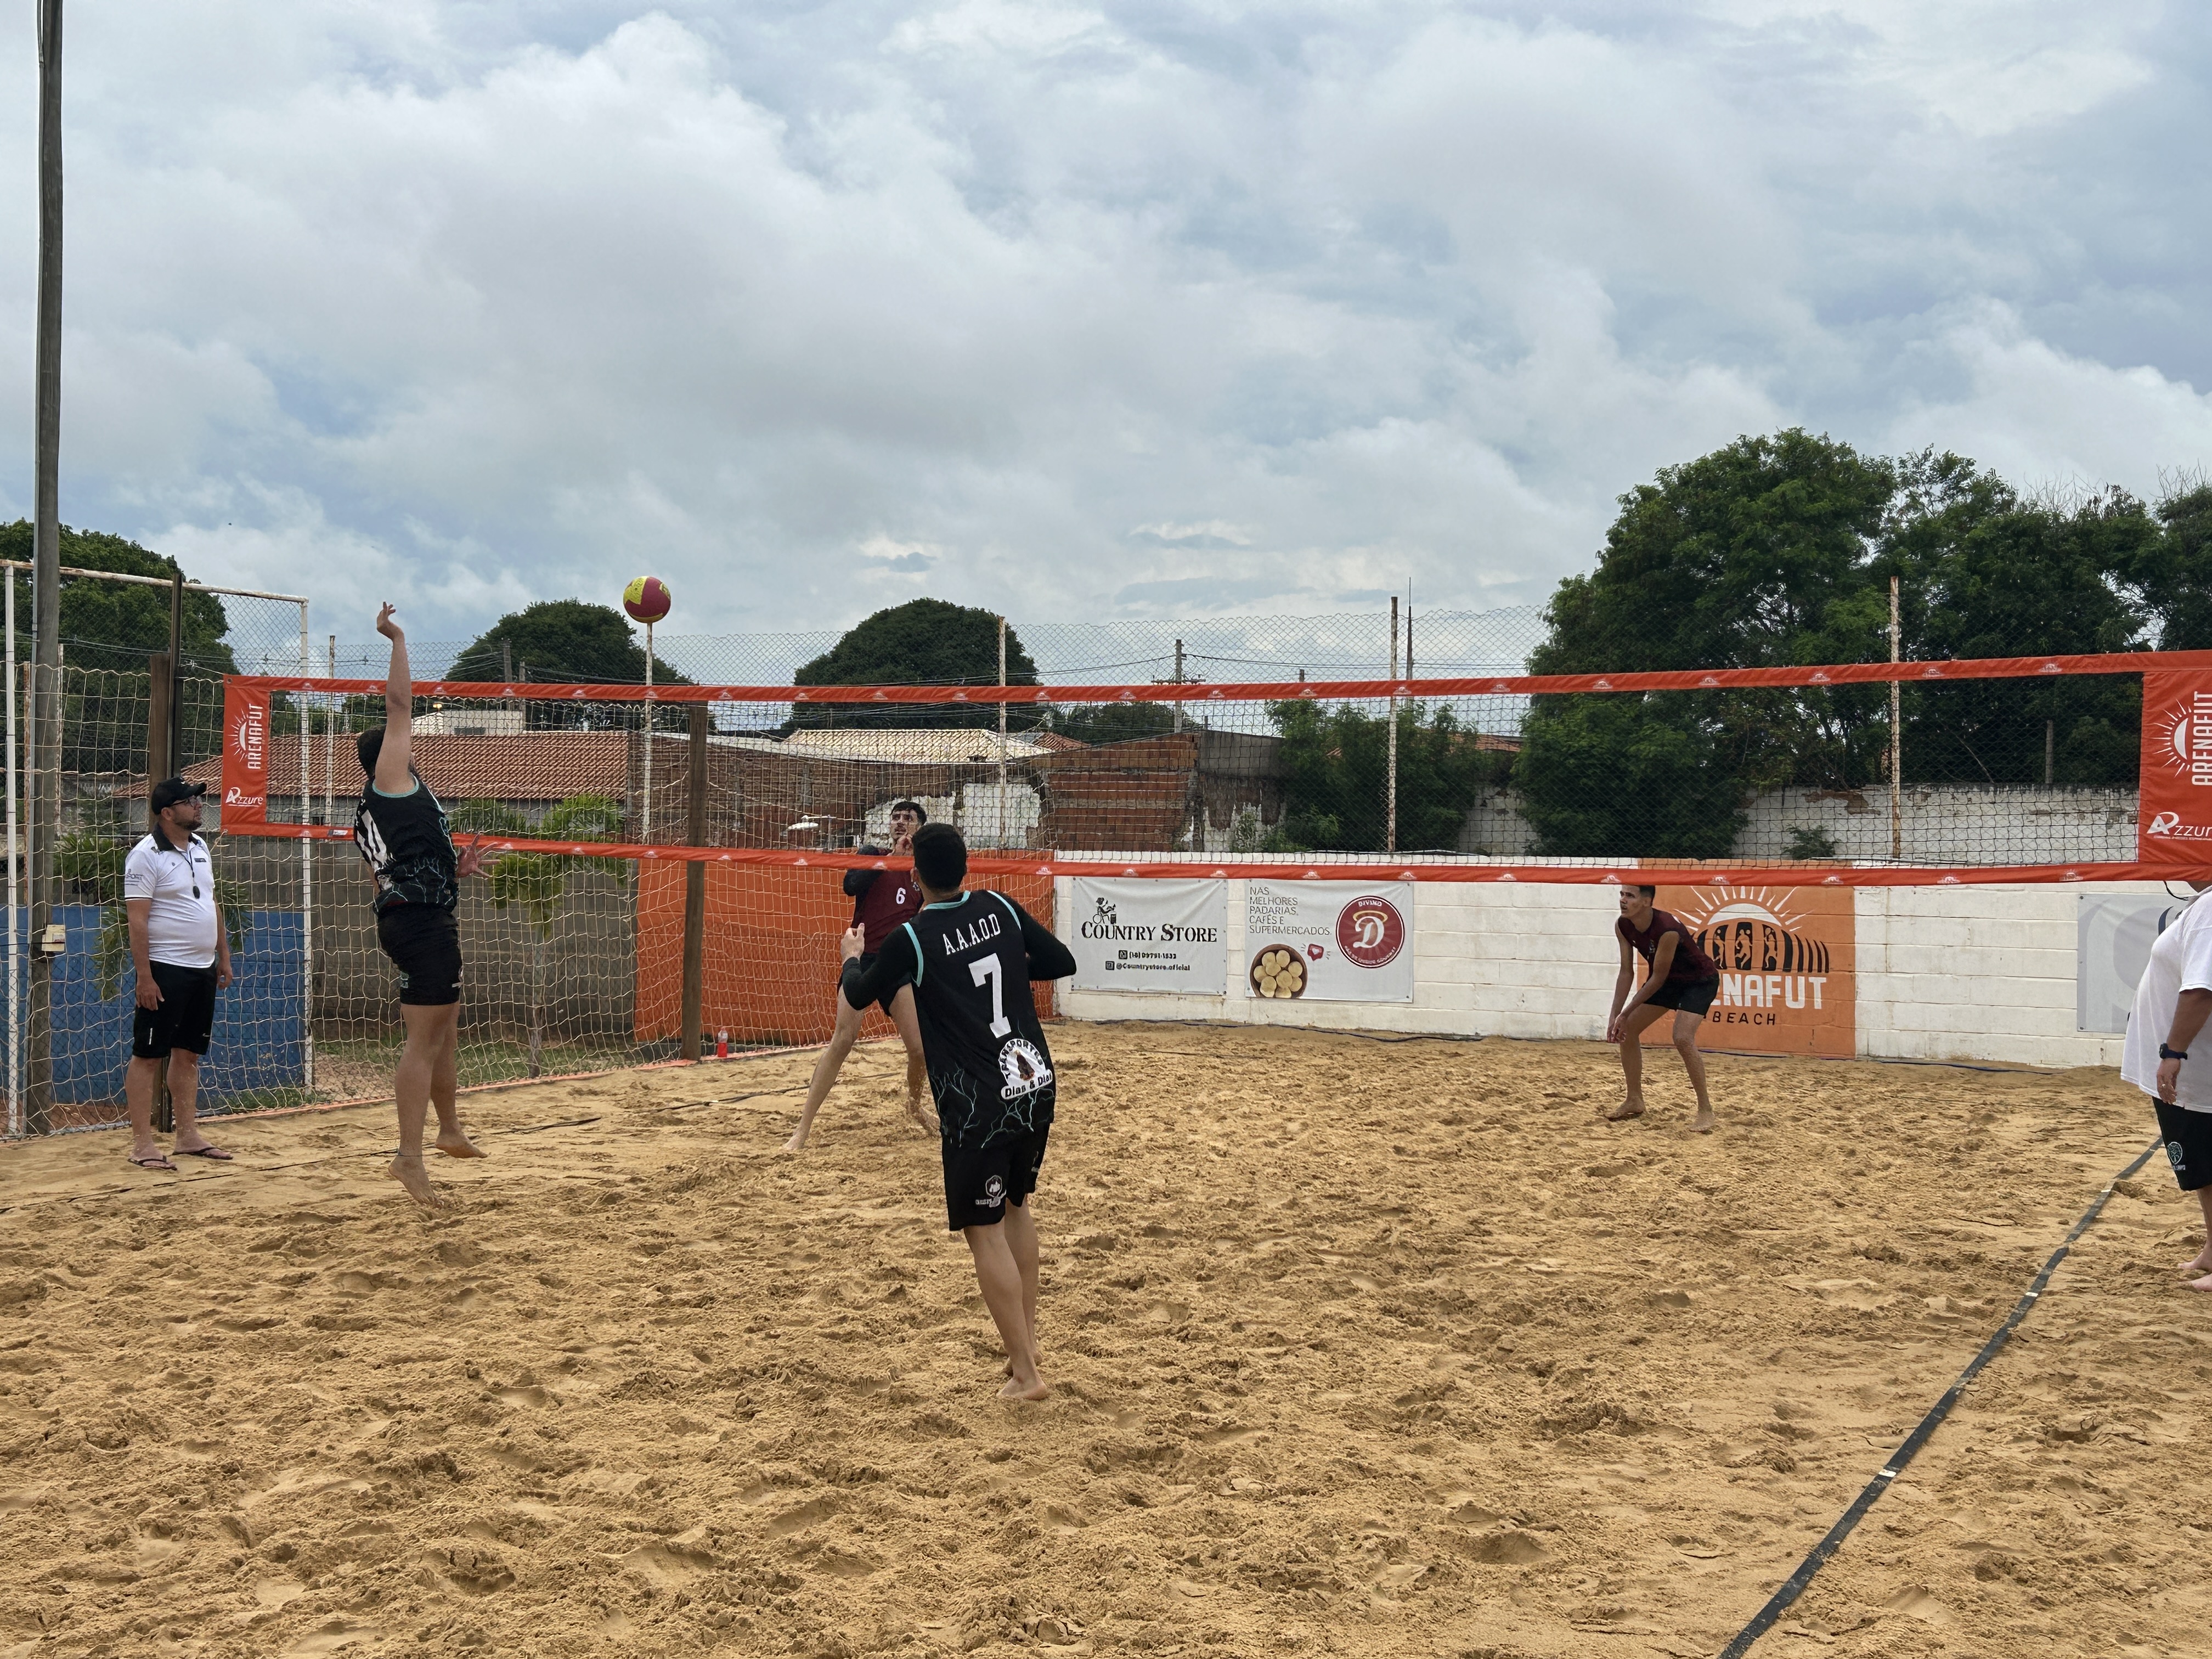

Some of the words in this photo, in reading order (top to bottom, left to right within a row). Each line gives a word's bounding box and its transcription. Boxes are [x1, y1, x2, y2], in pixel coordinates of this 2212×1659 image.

[247, 703, 263, 769] ARENAFUT
[896, 887, 906, 904] 6
[1250, 887, 1269, 895] NAS
[1250, 896, 1298, 906] MELHORES
[1249, 915, 1277, 924] CAFÉS
[1279, 916, 1284, 924] E
[1081, 921, 1156, 940] COUNTRY
[1160, 923, 1217, 943] STORE
[968, 952, 1012, 1039] 7
[1712, 1011, 1776, 1025] BEACH
[1029, 1080, 1035, 1089] &
